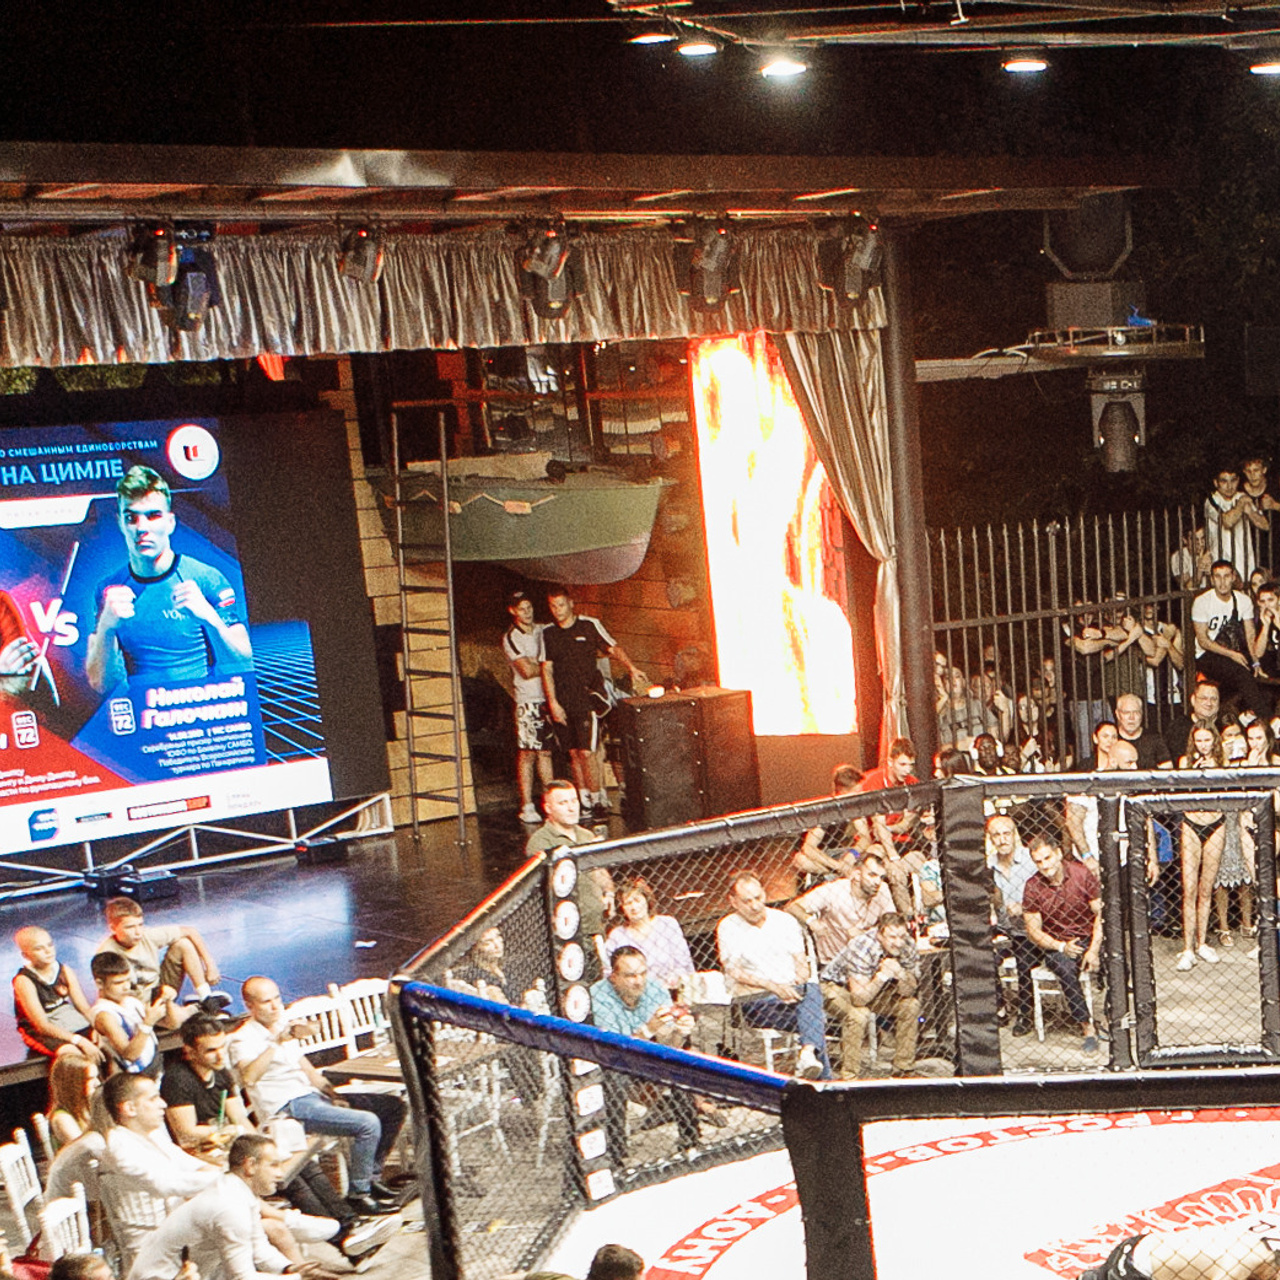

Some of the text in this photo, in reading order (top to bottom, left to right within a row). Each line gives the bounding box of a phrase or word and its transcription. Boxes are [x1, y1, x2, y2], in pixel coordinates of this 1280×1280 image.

[8, 445, 74, 457] СМЕШАННЫМ
[76, 440, 158, 453] ЕДИНОБОРСТВАМ
[1, 458, 124, 485] НА ЦИМЛЕ
[30, 598, 80, 646] VS
[145, 676, 246, 708] Николай
[141, 700, 248, 729] Галочкин
